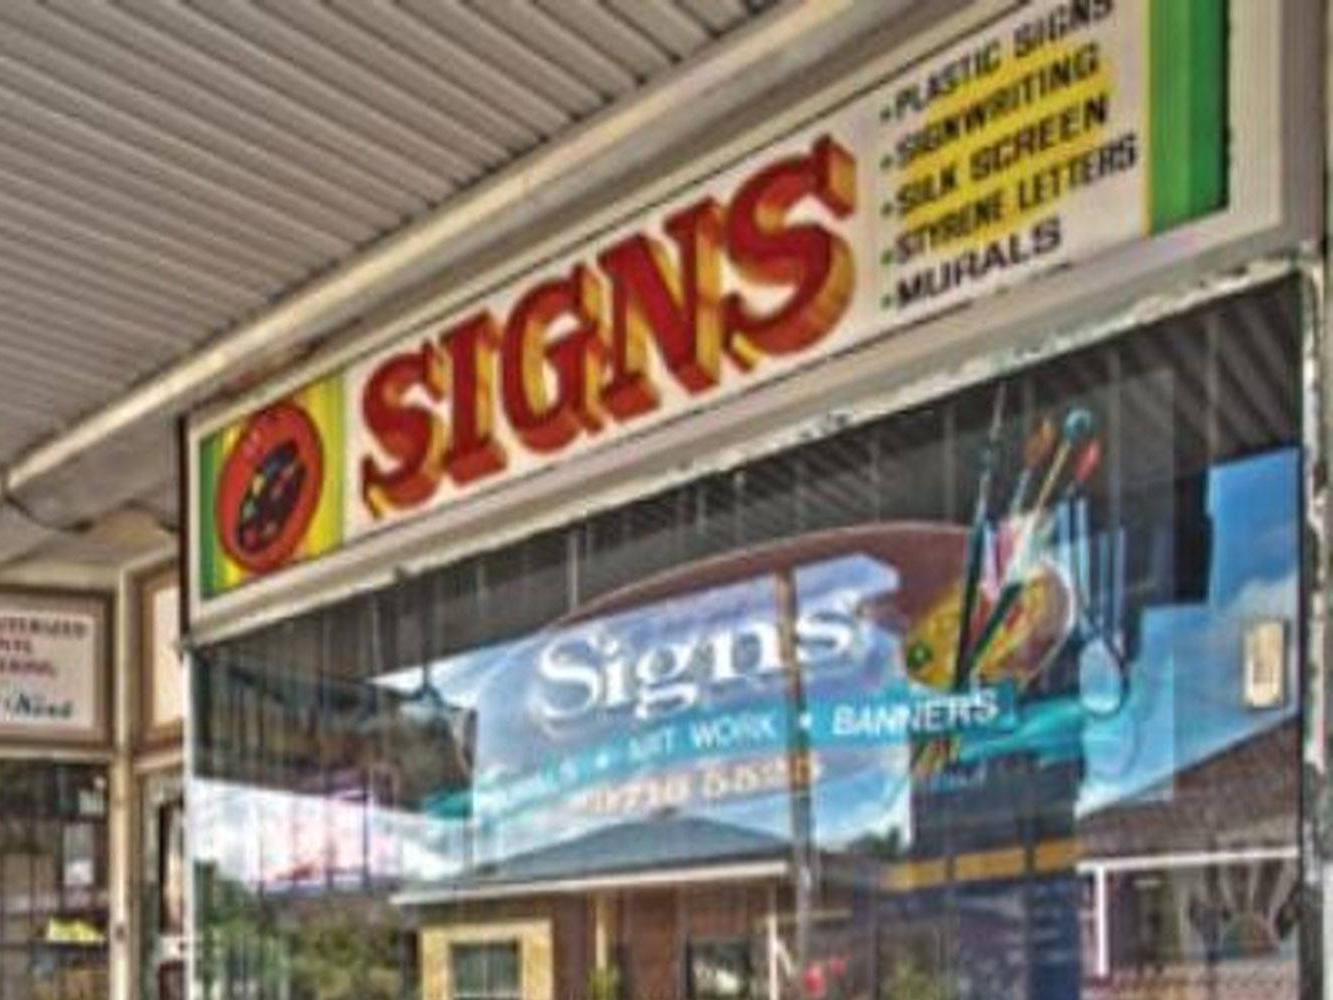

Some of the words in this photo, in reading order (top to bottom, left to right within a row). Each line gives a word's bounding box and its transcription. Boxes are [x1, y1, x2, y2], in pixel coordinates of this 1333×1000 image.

[894, 38, 1002, 120] PLASTIC
[895, 41, 1102, 168] SIGNWRITING
[895, 188, 1004, 265] STYRENE
[1018, 131, 1138, 214] LETTERS
[896, 160, 958, 217] SILK
[968, 92, 1110, 183] SCREEN
[896, 215, 1061, 309] MURALS
[360, 134, 858, 519] SIGNS
[534, 586, 858, 722] Signs
[690, 711, 779, 750] WORK
[831, 690, 999, 738] BANNERS
